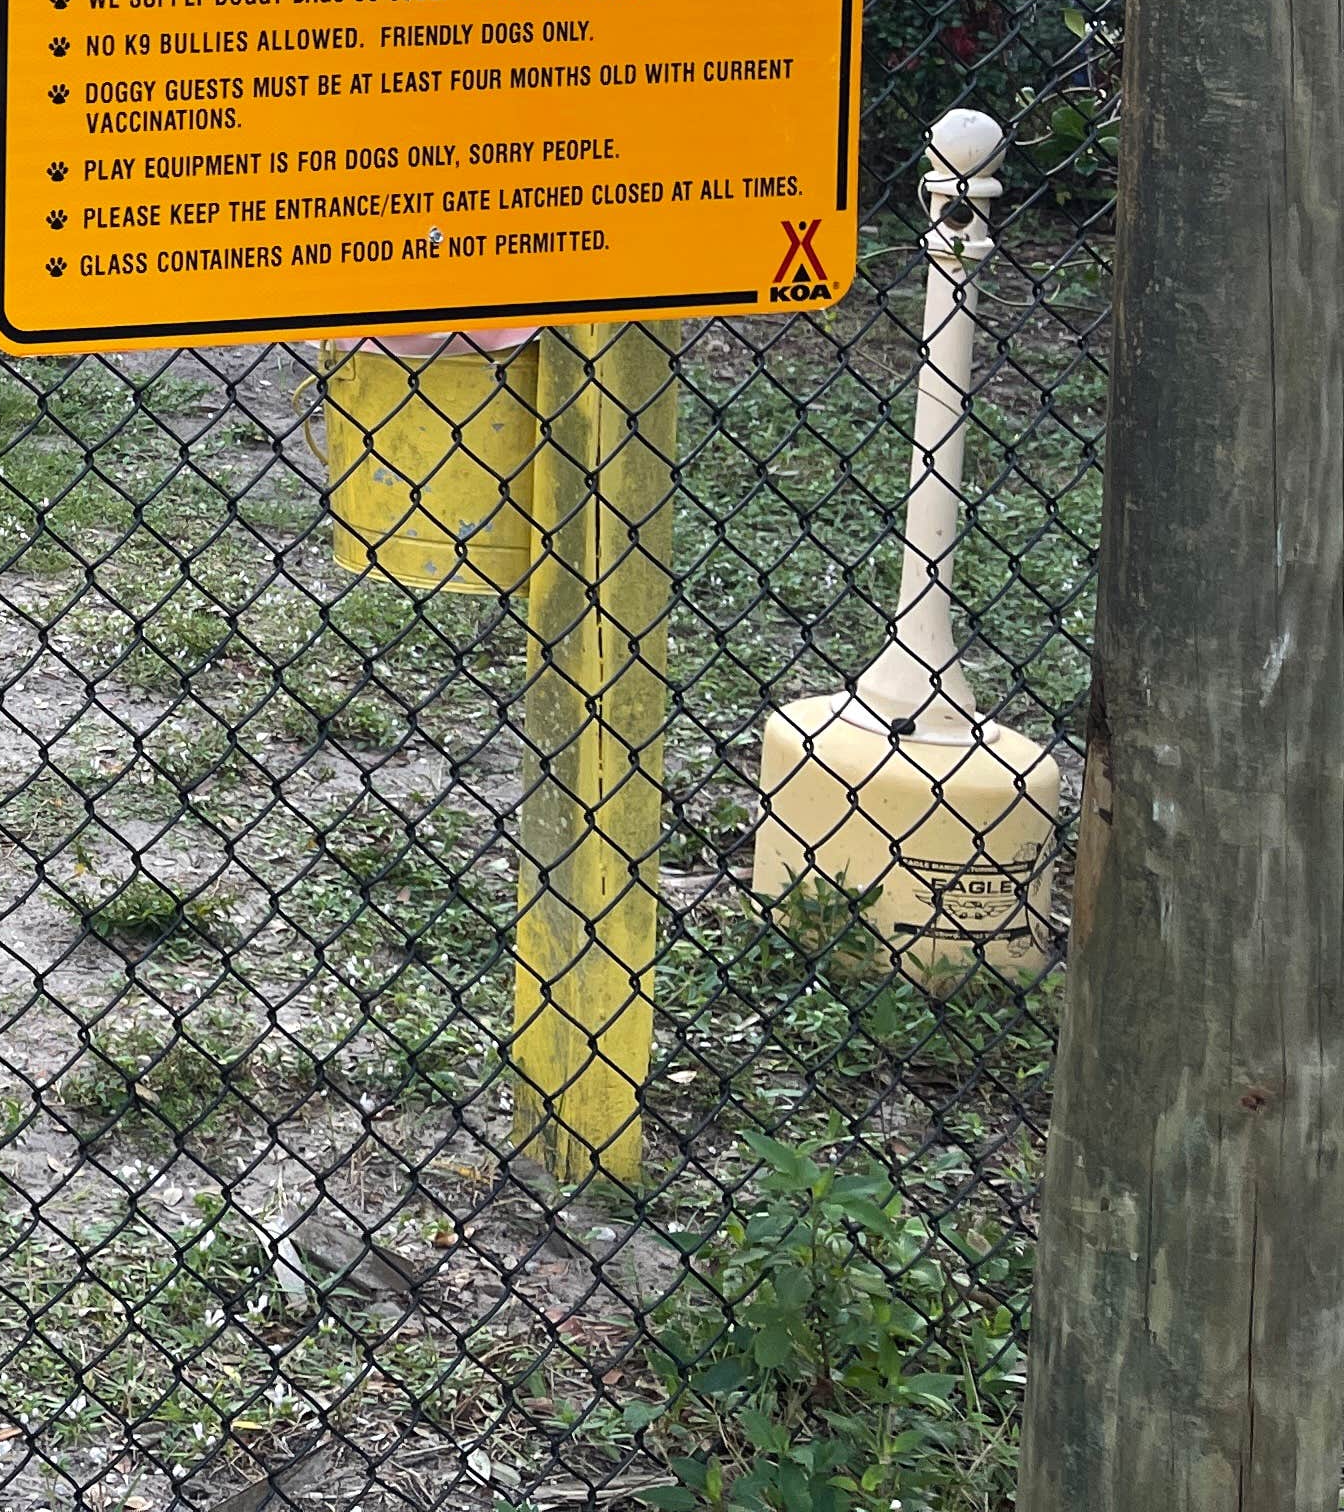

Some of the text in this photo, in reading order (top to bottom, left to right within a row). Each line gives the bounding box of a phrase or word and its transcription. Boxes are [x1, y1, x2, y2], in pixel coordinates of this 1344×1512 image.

[86, 20, 594, 57] NO K9 BULLIES ALLOWED. FRIENDLY DOGS ONLY.
[85, 58, 794, 104] DOGGY GUESTS MUST BE AT LEAST FOUR MONTHS OLD WITH CURRENT
[86, 107, 242, 134] VACCINATIONS.
[84, 138, 619, 182] PLAY EQUIPMENT IS FOR DOGS ONLY, SORRY PEOPLE.
[83, 175, 803, 229] PLEASE KEEP THE ENTRANCE/EXIT GATE LATCHED CLOSED AT ALL TIMES.
[80, 229, 609, 277] GLASS CONTAINERS AND FOOD ARE NOT PERMITTED.
[769, 284, 833, 303] KOA
